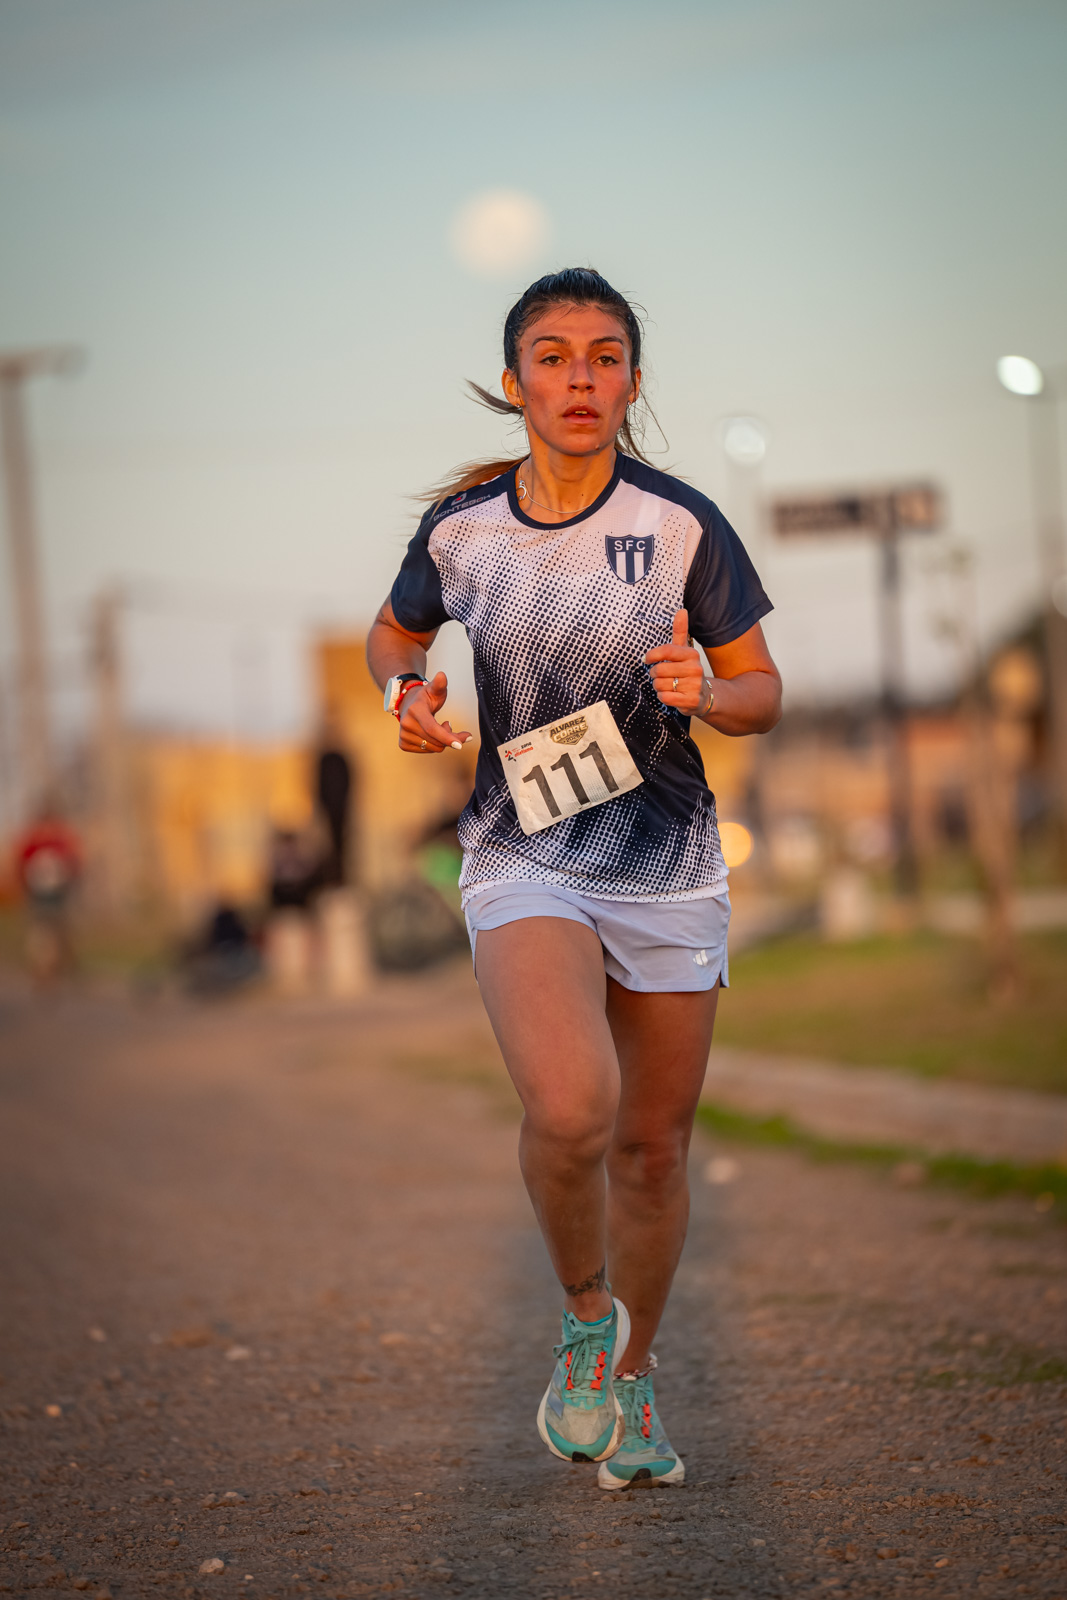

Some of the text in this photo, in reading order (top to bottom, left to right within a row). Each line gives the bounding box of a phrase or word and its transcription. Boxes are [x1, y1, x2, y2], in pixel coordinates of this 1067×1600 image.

[614, 540, 646, 551] SFC
[550, 716, 585, 737] ALVAREZ
[553, 724, 586, 742] CORRE
[522, 741, 619, 818] 111
